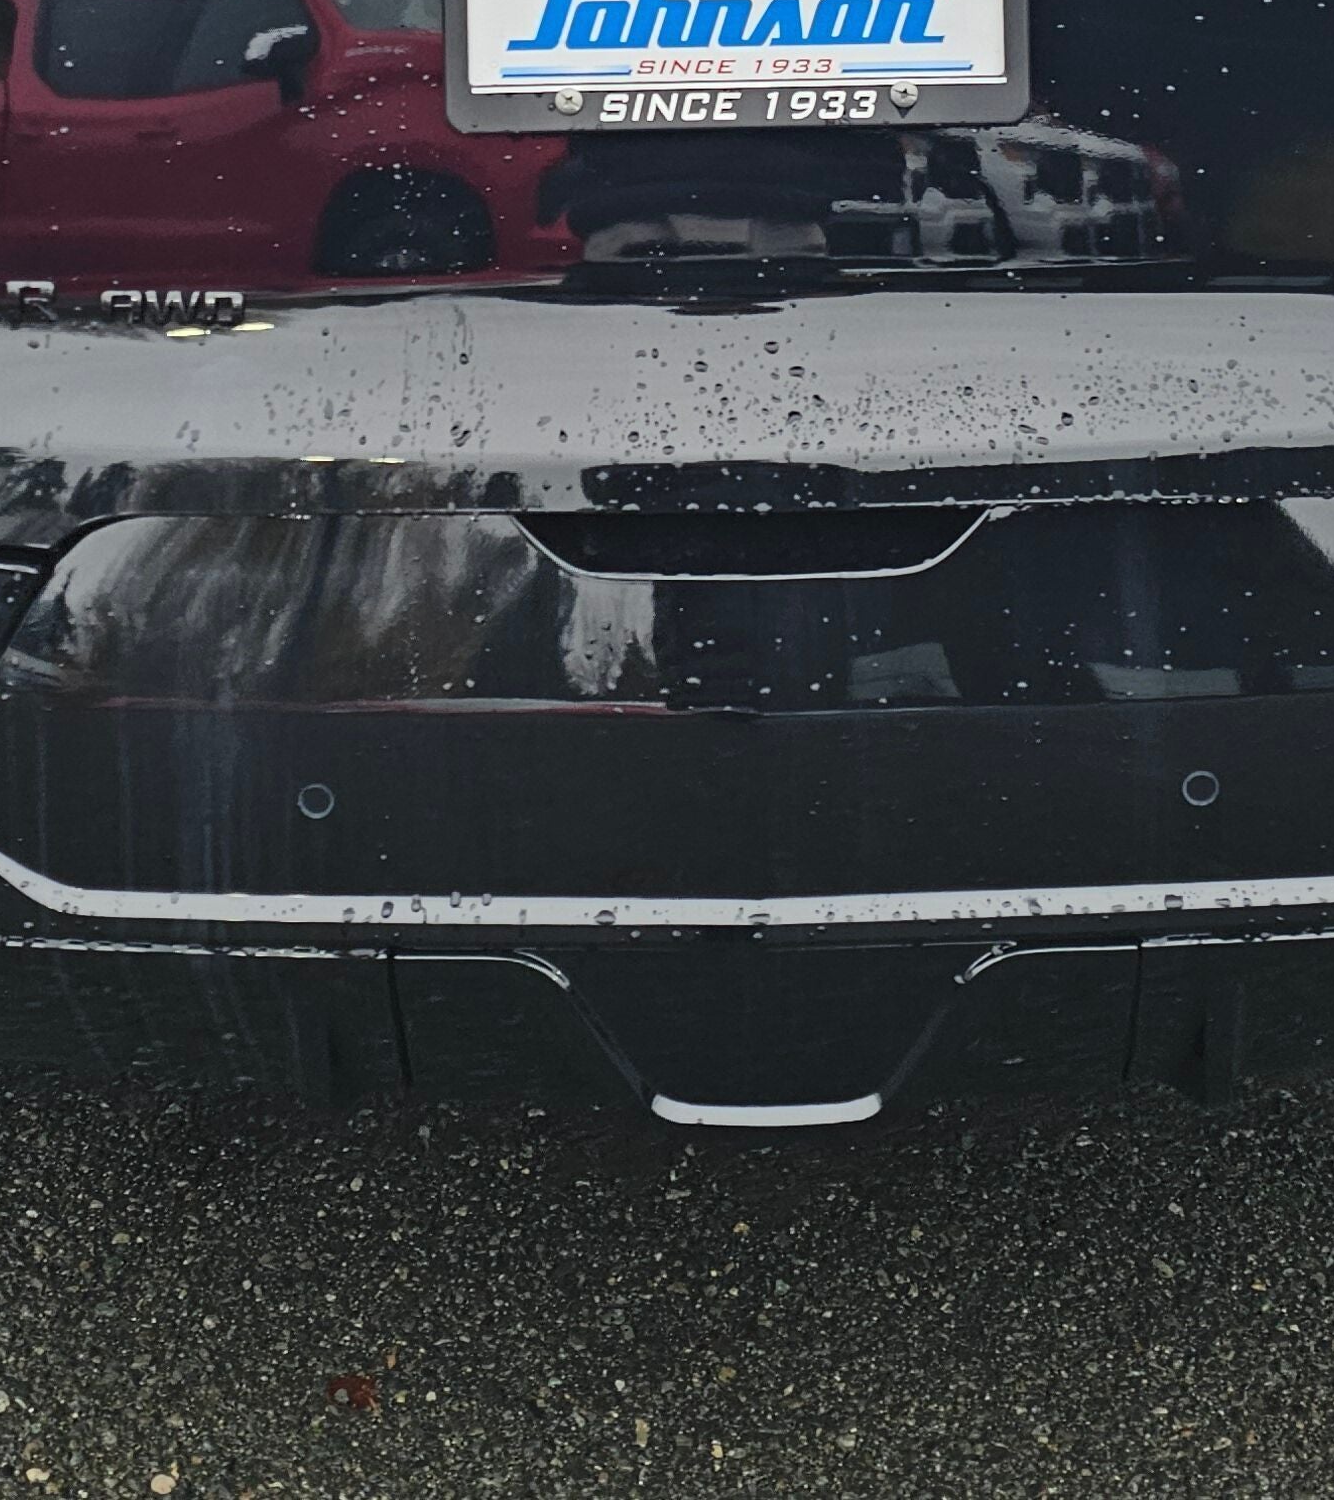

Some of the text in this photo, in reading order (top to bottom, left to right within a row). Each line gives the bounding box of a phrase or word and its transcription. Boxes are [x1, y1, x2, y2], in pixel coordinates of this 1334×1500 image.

[636, 58, 834, 75] SINCE 1933
[599, 89, 877, 124] SINCE 1933
[100, 290, 244, 324] AWD
